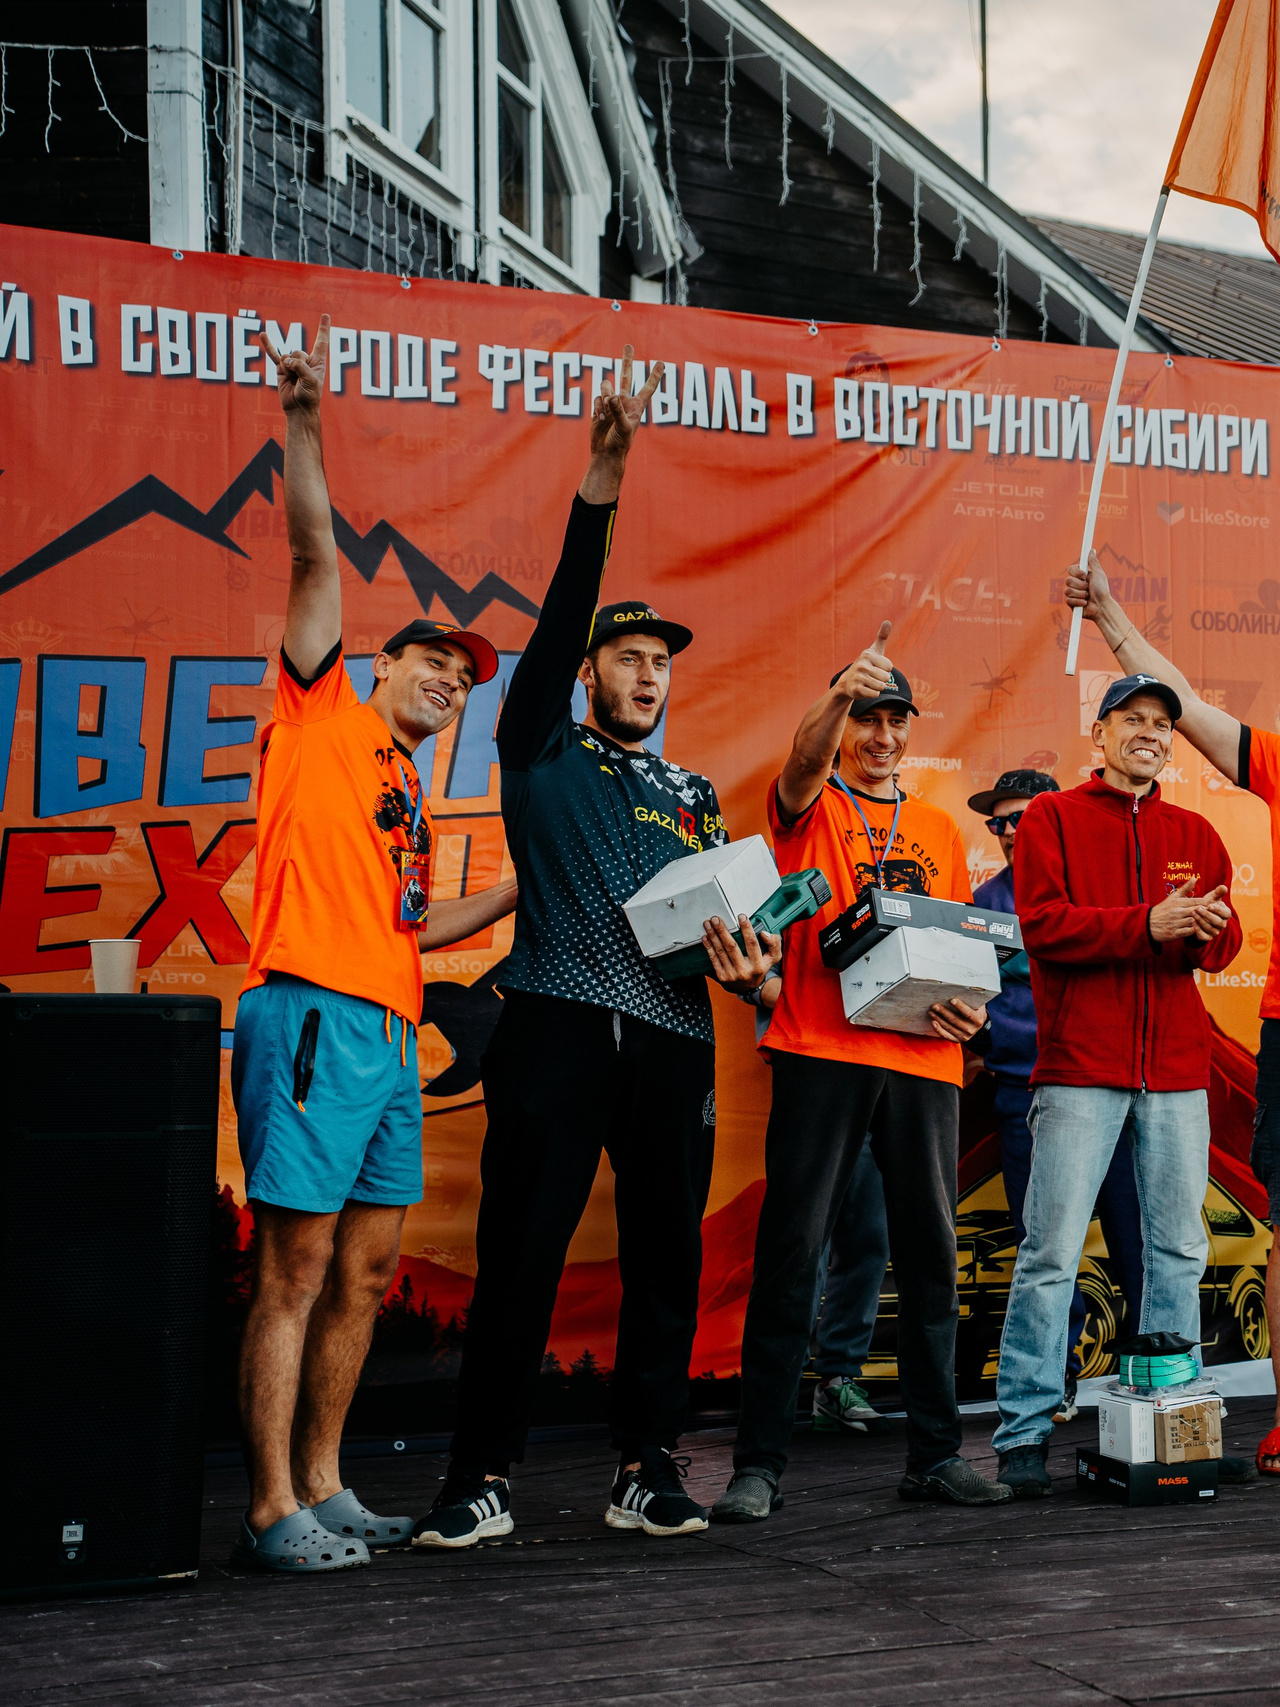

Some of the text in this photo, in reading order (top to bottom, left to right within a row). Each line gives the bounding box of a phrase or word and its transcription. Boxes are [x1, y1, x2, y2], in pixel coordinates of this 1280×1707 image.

[56, 293, 94, 366] В
[121, 303, 303, 387] СВОЁМ
[329, 326, 457, 404] РОДЕ
[786, 371, 815, 436] В
[833, 376, 1090, 460] ВОСТОЧНОЙ
[1109, 404, 1269, 476] СИБИРИ
[952, 480, 1045, 499] JETOUR
[1189, 507, 1271, 530] LikeStore
[961, 922, 987, 933] MASS
[1205, 970, 1267, 988] LikeSto
[1157, 1477, 1189, 1486] MASS
